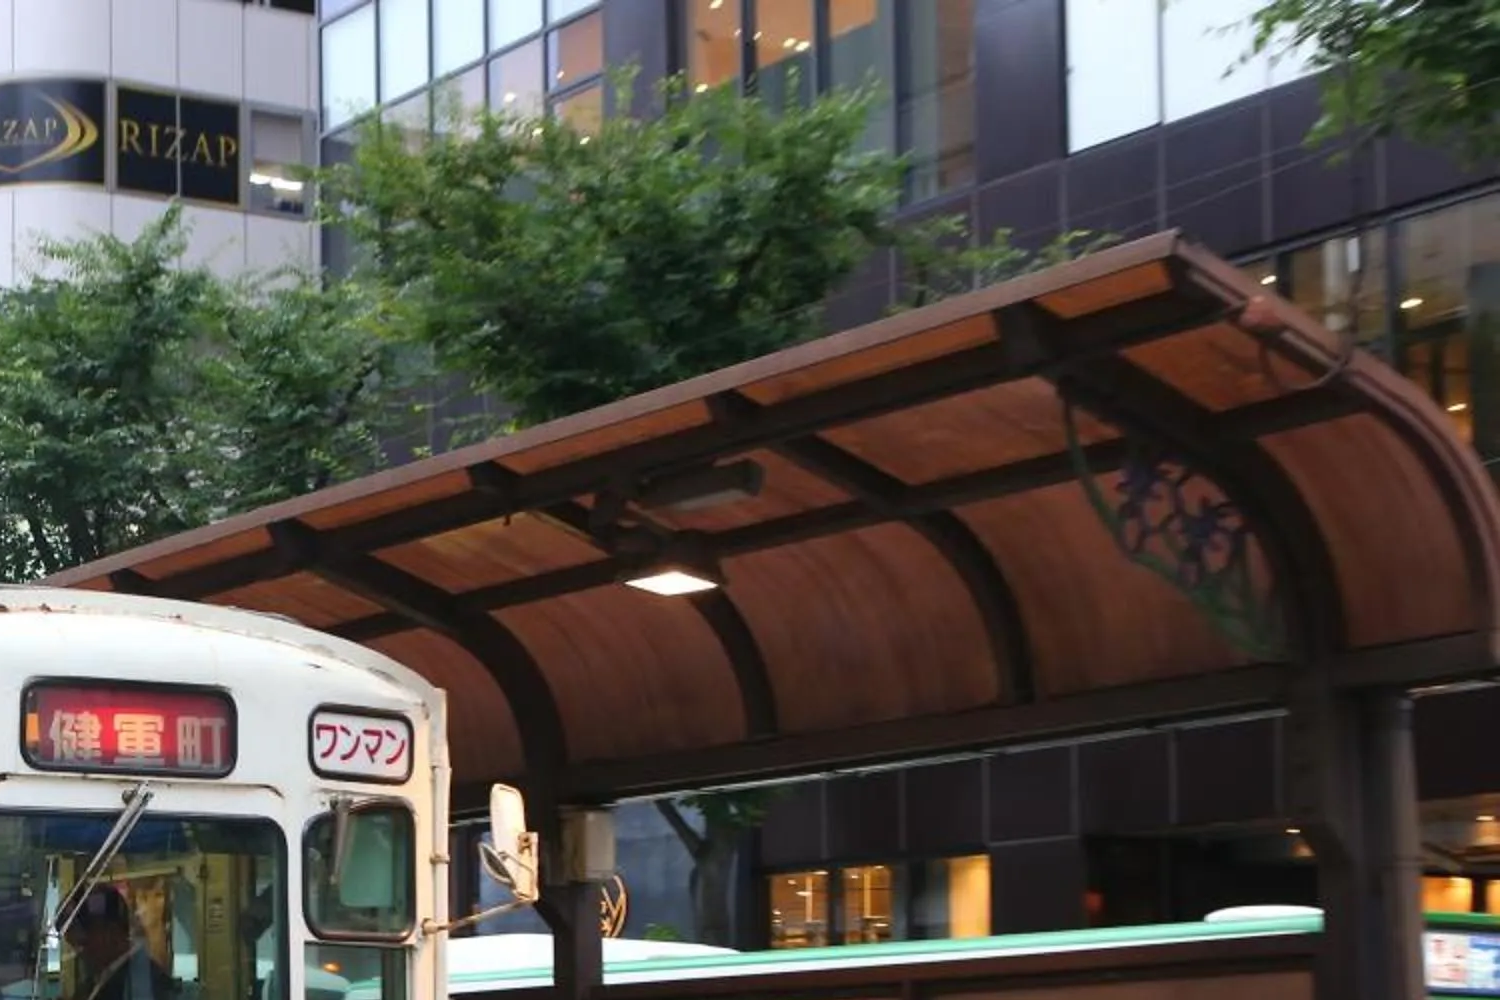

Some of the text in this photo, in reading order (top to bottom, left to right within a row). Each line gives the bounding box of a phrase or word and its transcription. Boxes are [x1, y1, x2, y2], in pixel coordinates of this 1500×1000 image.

[118, 118, 238, 168] RIZAP
[48, 709, 227, 769] 健軍町
[315, 723, 406, 766] ワンマン
